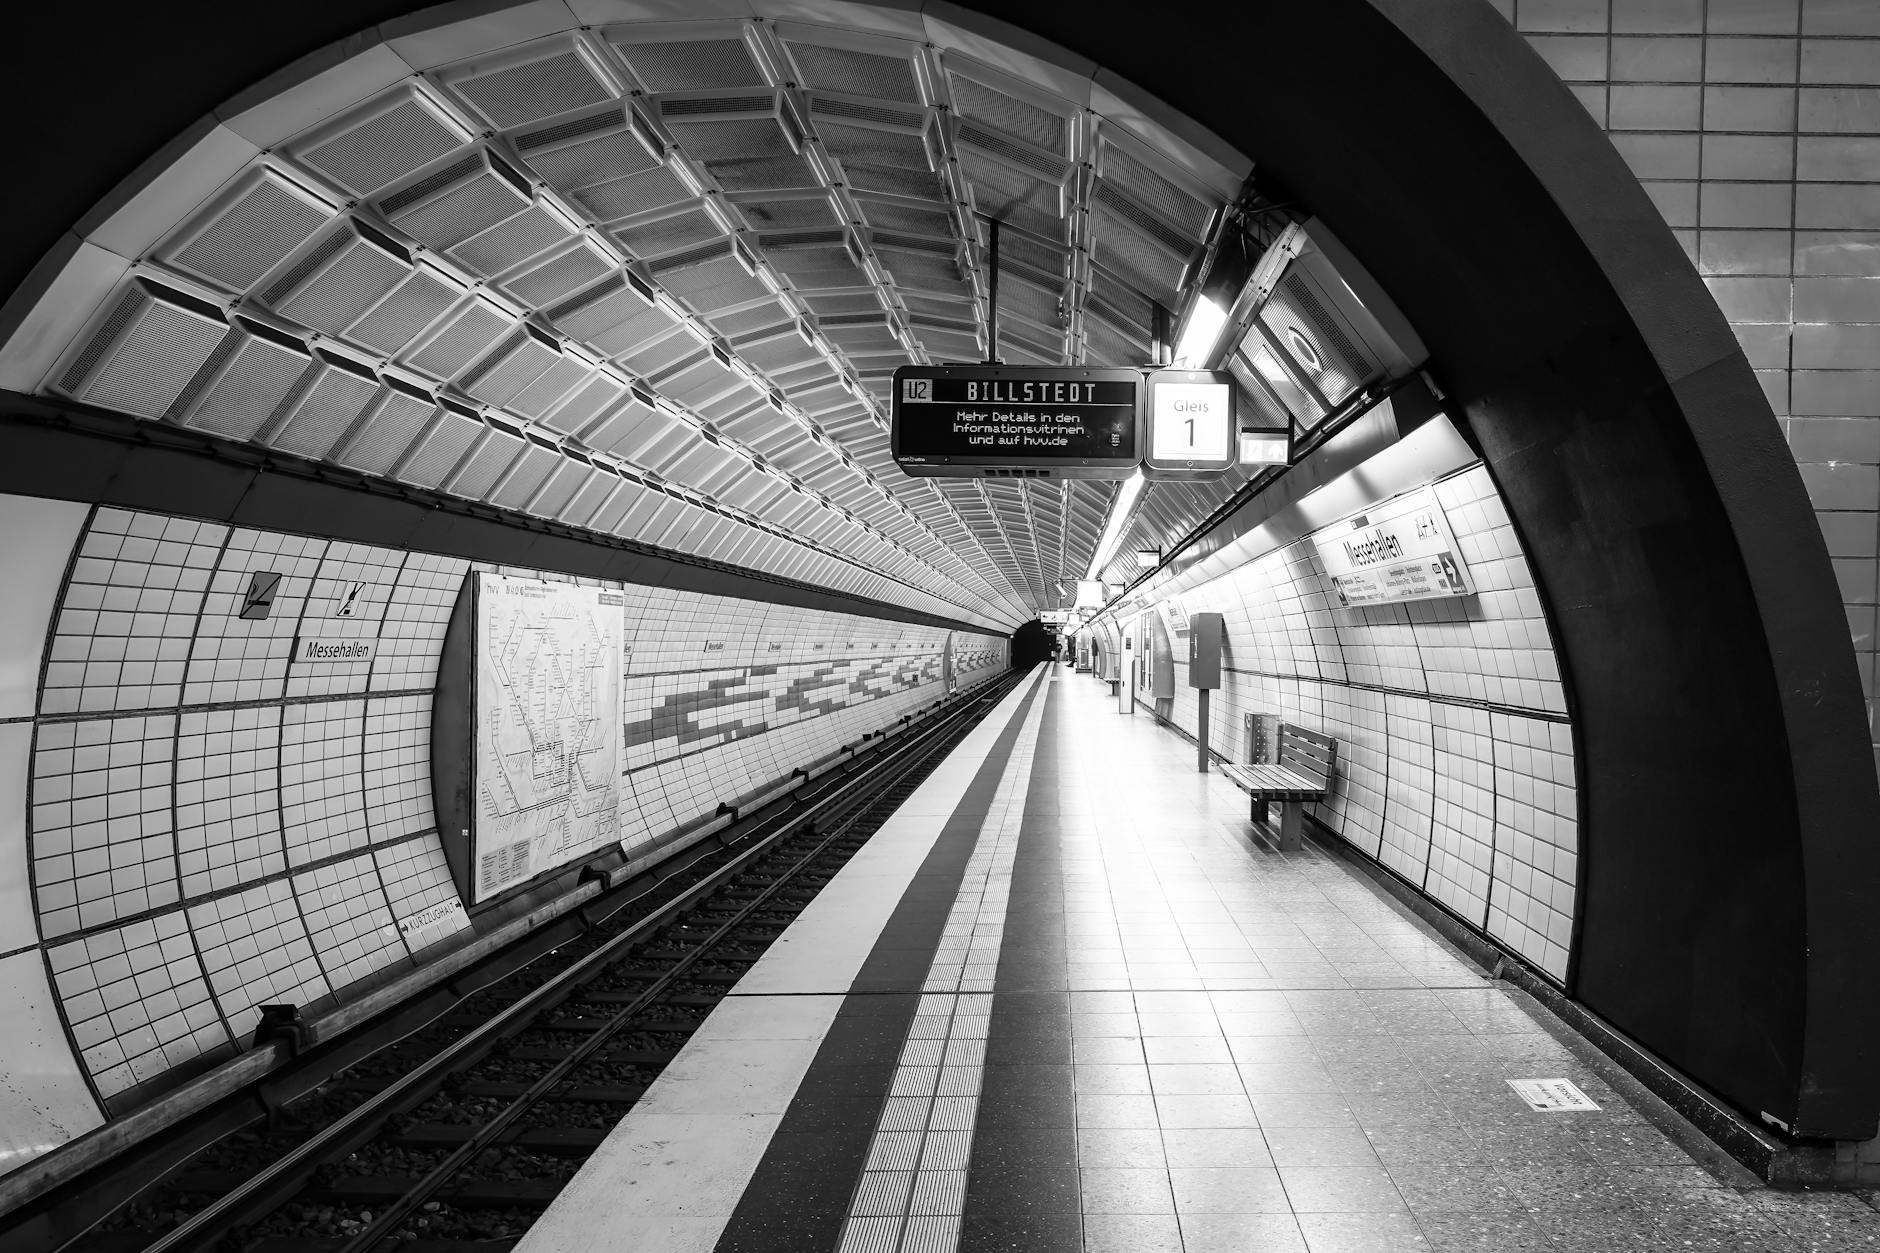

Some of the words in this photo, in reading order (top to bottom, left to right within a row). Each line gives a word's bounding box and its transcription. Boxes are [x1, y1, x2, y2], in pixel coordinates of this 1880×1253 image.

[909, 381, 927, 400] U2
[967, 381, 1096, 402] BILLSTEDT
[1173, 399, 1209, 413] Gleis
[956, 411, 988, 422] Mehr
[992, 412, 1036, 423] Details
[1040, 412, 1051, 423] in
[1055, 412, 1081, 424] den
[953, 422, 1085, 435] Informationsvitrinen
[1184, 418, 1194, 447] 1
[969, 434, 994, 445] und
[998, 434, 1020, 446] auf
[1024, 435, 1068, 446] hvv.de
[1342, 528, 1404, 568] Messehallen
[305, 641, 369, 658] Messehallen
[408, 902, 456, 931] KURZZUGHALT
